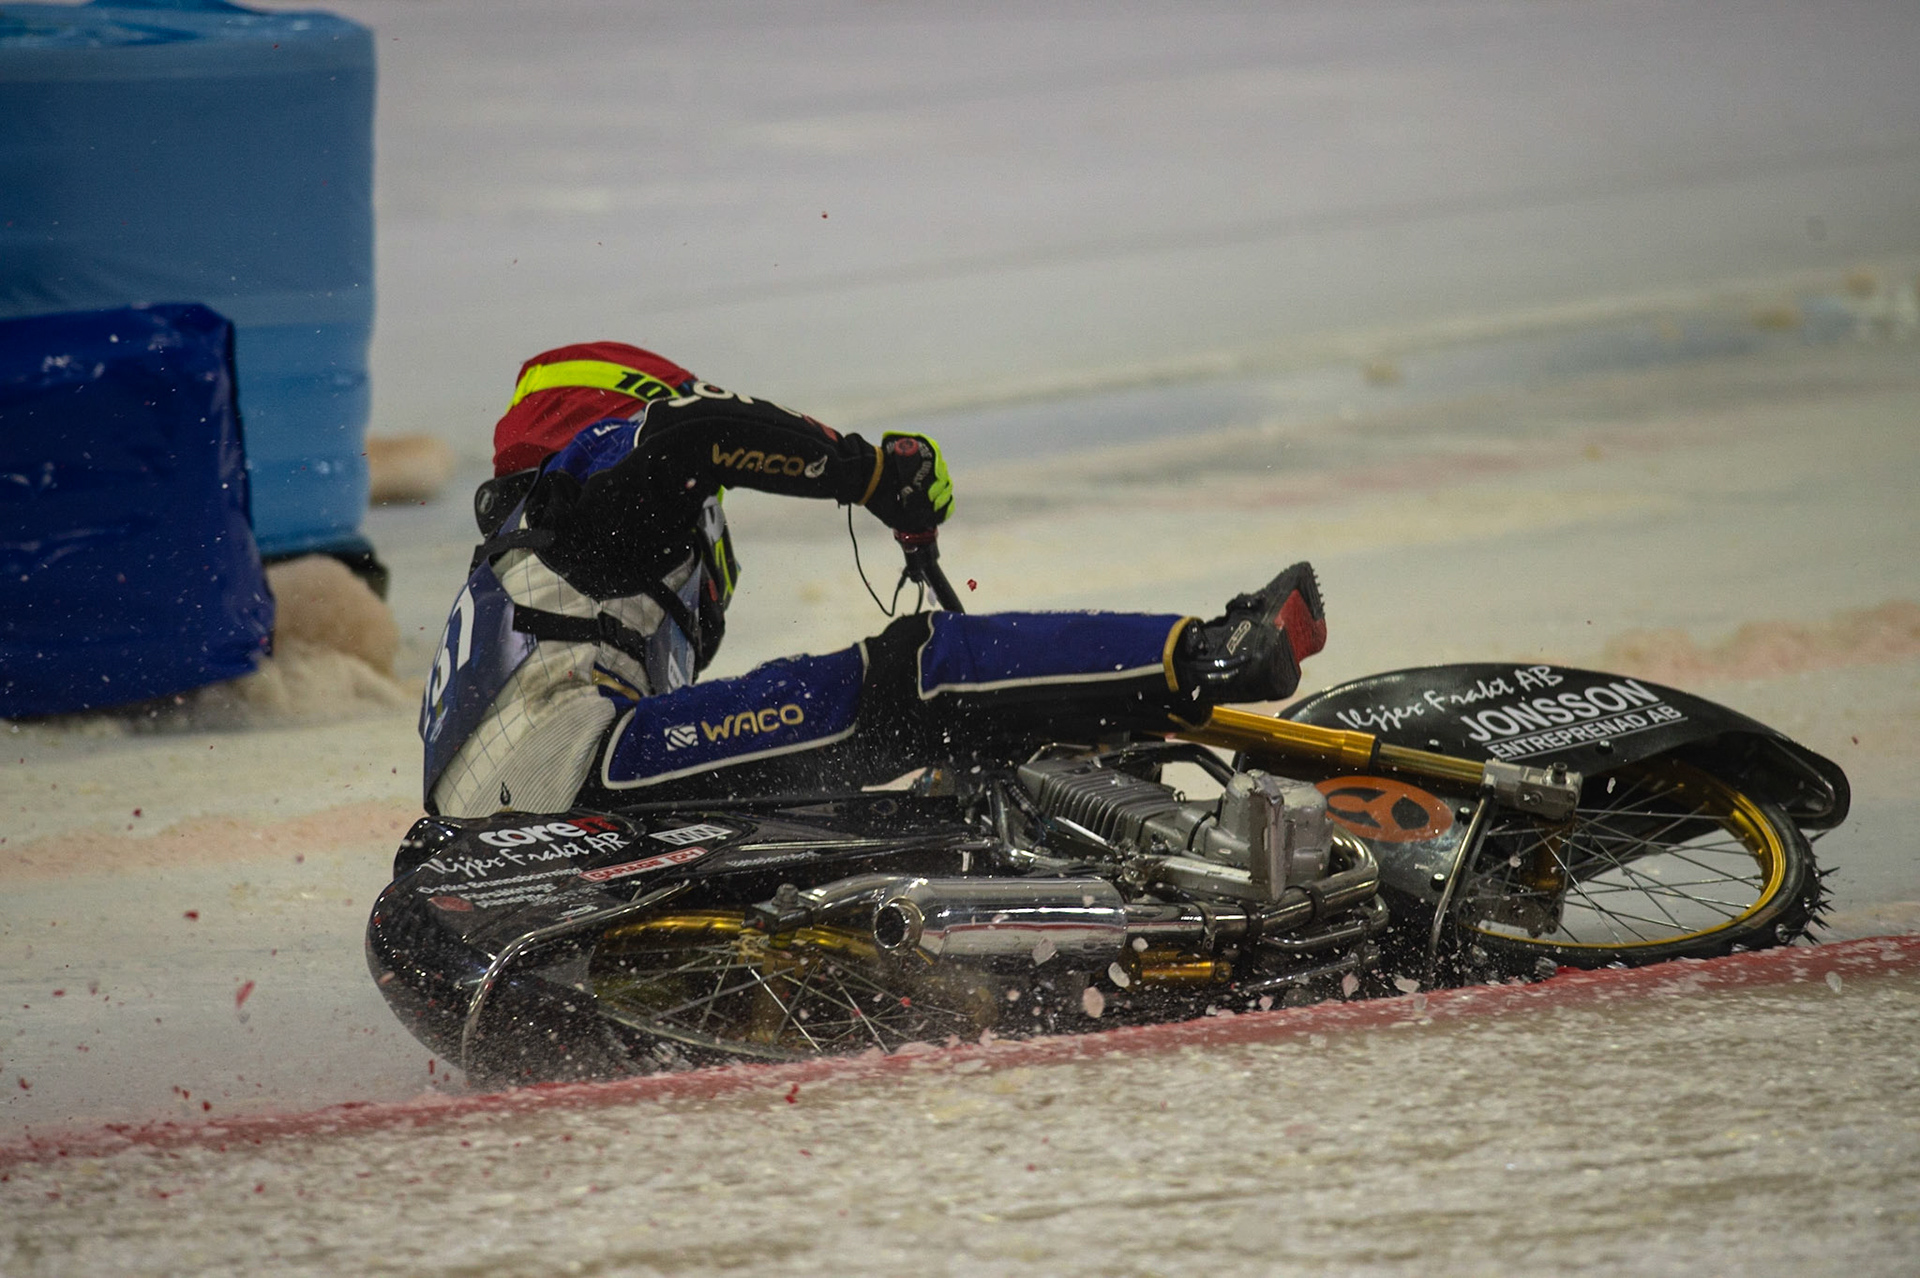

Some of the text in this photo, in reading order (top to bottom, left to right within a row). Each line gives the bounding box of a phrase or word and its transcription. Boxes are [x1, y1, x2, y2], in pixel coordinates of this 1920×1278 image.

[615, 371, 673, 400] 10
[711, 443, 805, 476] WACO
[1424, 677, 1514, 712] Frakt
[1514, 665, 1564, 691] AB
[701, 704, 804, 741] WACO
[1460, 679, 1660, 742] JONSSON
[1487, 705, 1682, 759] ENTREPRENAD AB
[499, 843, 589, 867] Frakt
